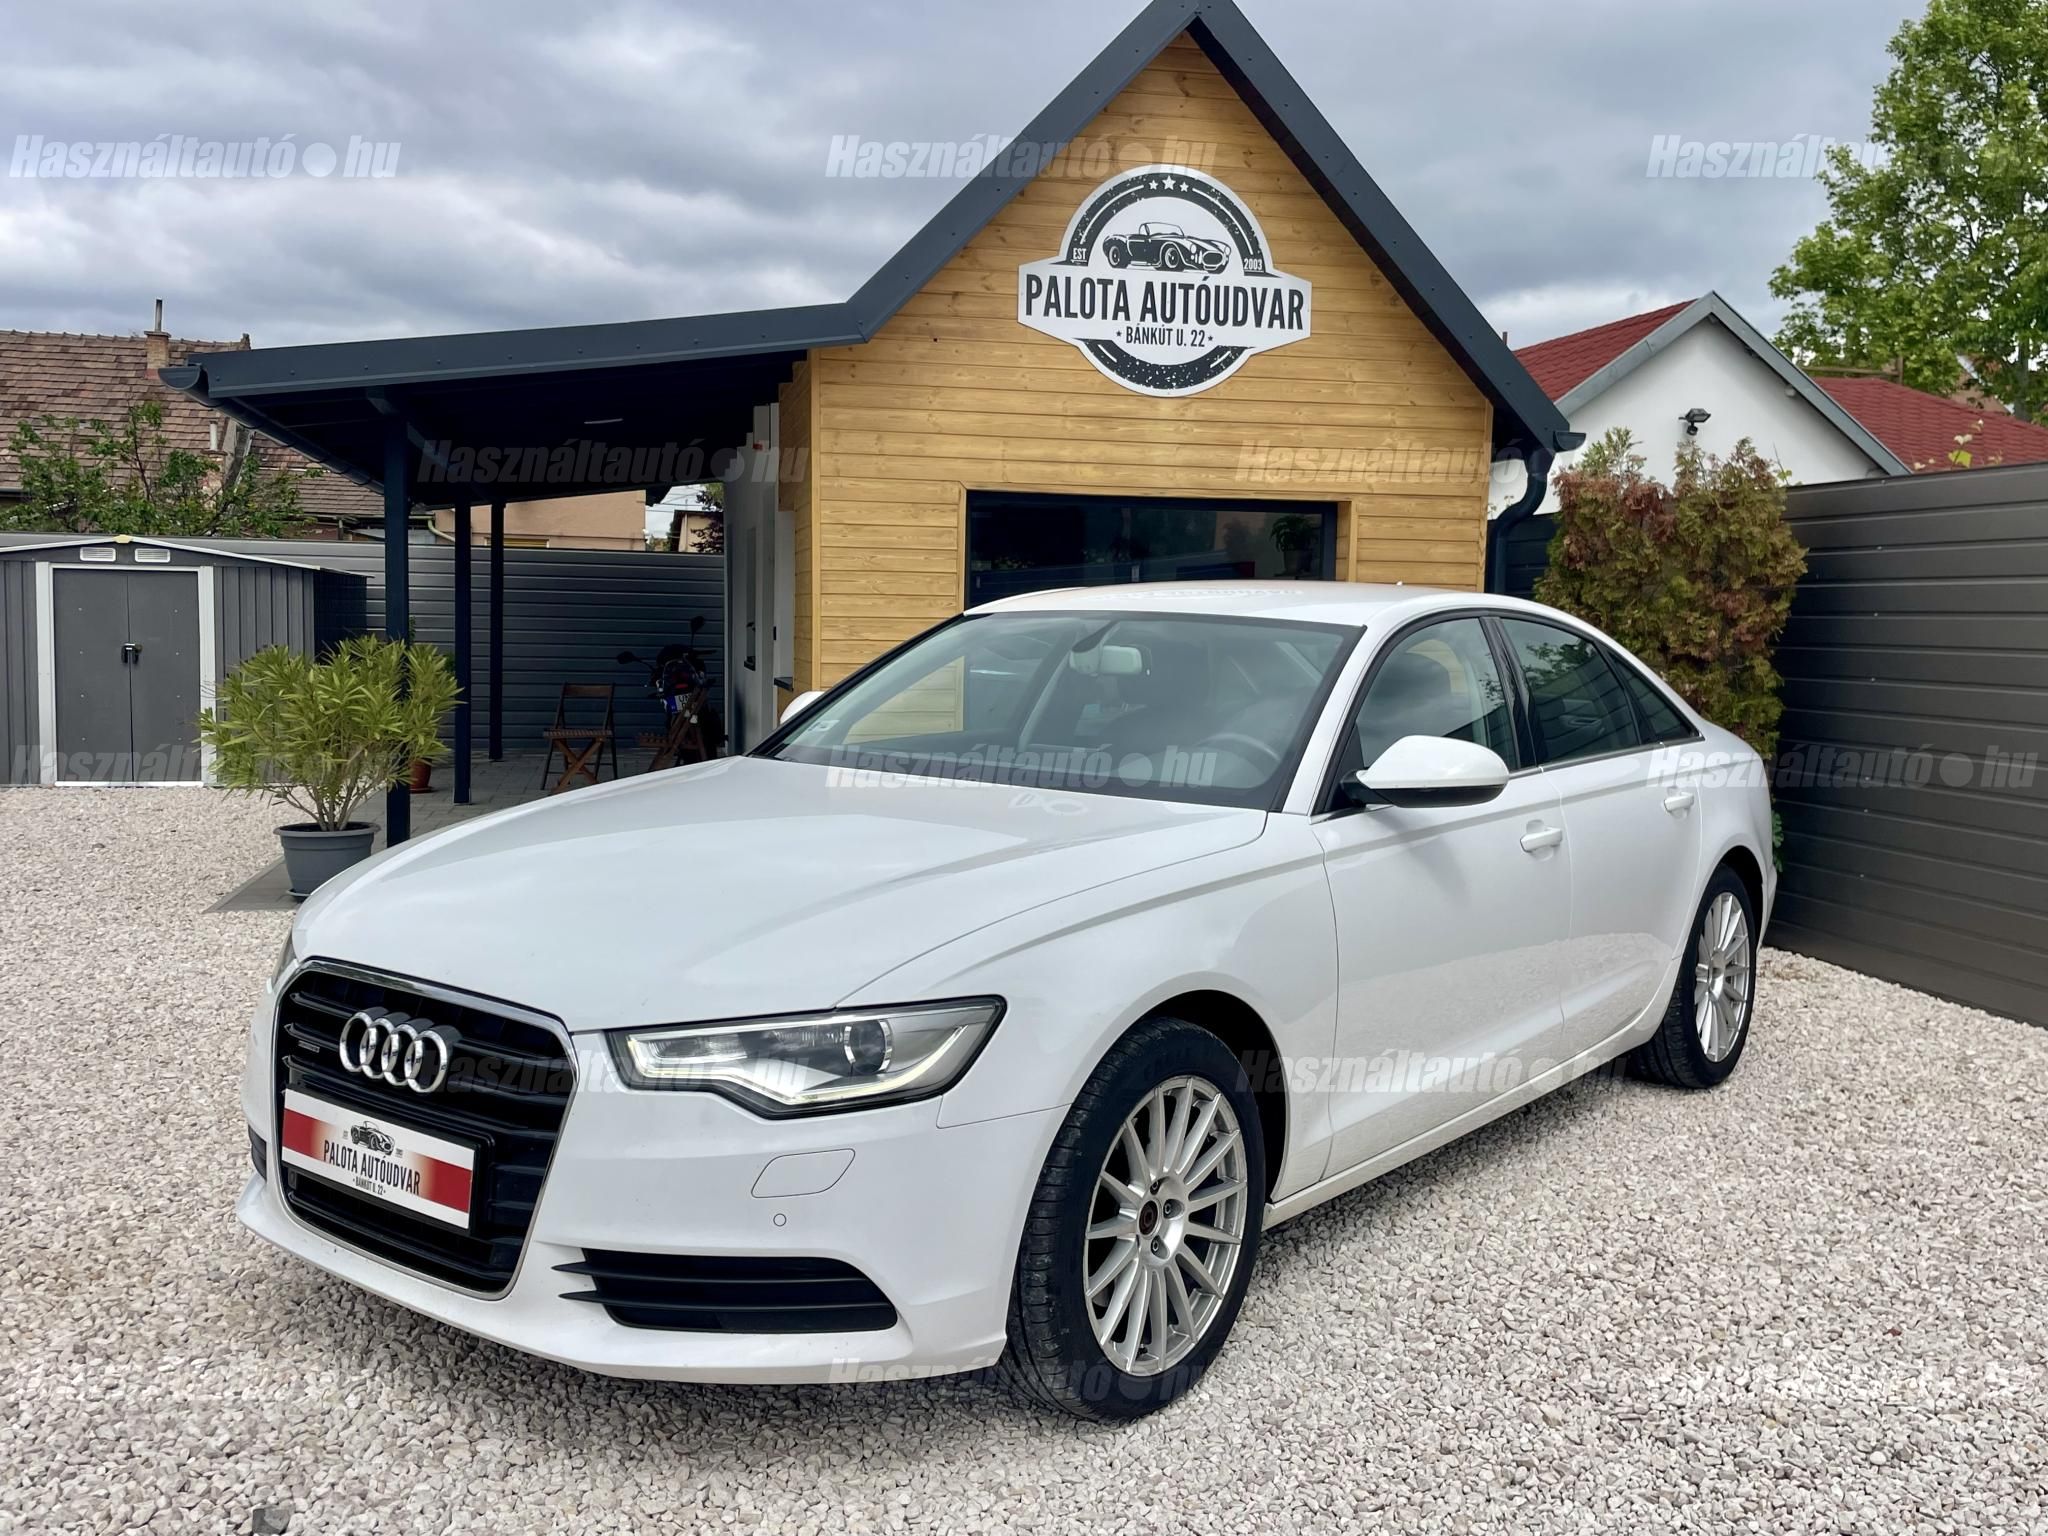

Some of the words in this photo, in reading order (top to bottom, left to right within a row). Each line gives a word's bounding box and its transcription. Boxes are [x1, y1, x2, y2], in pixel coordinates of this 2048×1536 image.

[1072, 247, 1088, 260] EST
[1243, 257, 1263, 271] 2003
[1025, 273, 1131, 321] PALOTA
[1139, 275, 1304, 330] AUTÓUDVAR
[1125, 323, 1174, 346] BÁNKÚT
[1190, 329, 1205, 347] 22
[323, 1140, 358, 1174] PALOTA
[360, 1155, 421, 1196] AUTÓUDVAR
